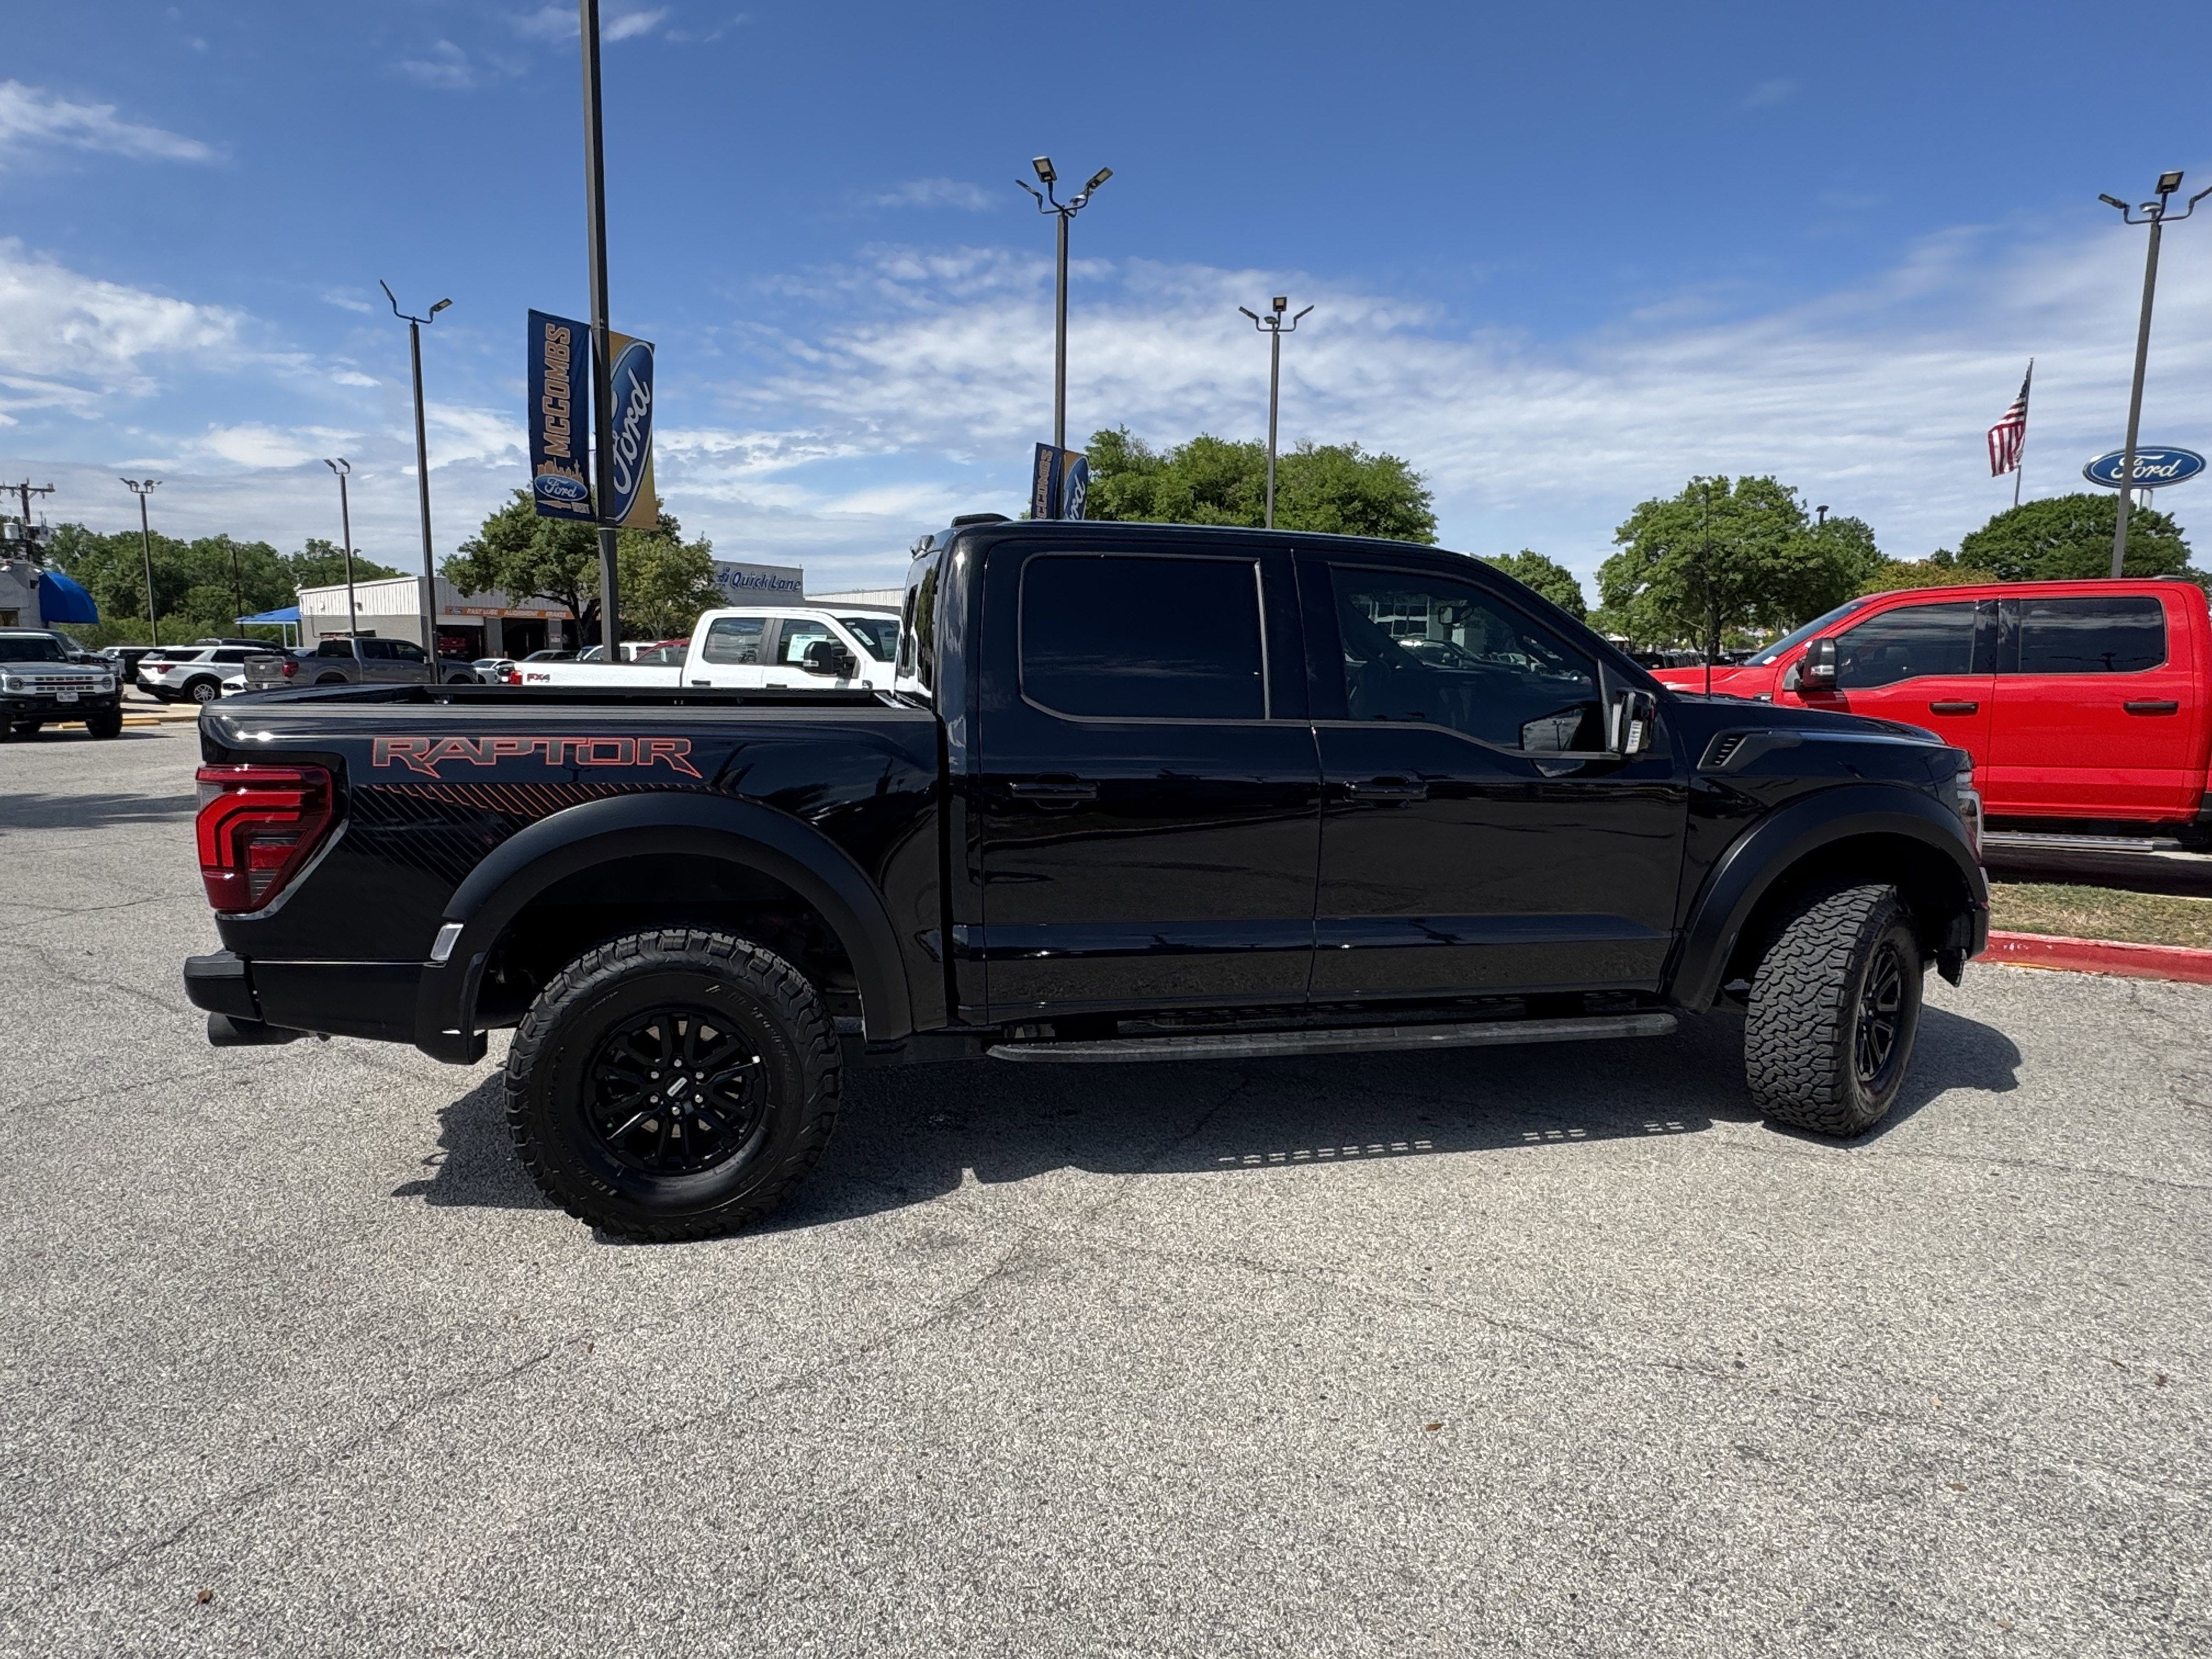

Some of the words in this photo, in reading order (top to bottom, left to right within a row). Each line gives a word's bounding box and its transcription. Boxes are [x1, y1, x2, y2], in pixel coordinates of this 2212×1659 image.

[542, 323, 571, 459] MCCOMBS
[544, 477, 577, 498] Ford
[1036, 449, 1053, 519] CCOMBS
[730, 571, 768, 589] Quick
[769, 574, 802, 591] Lane
[527, 673, 551, 682] FX4
[373, 737, 703, 779] RAPTOR
